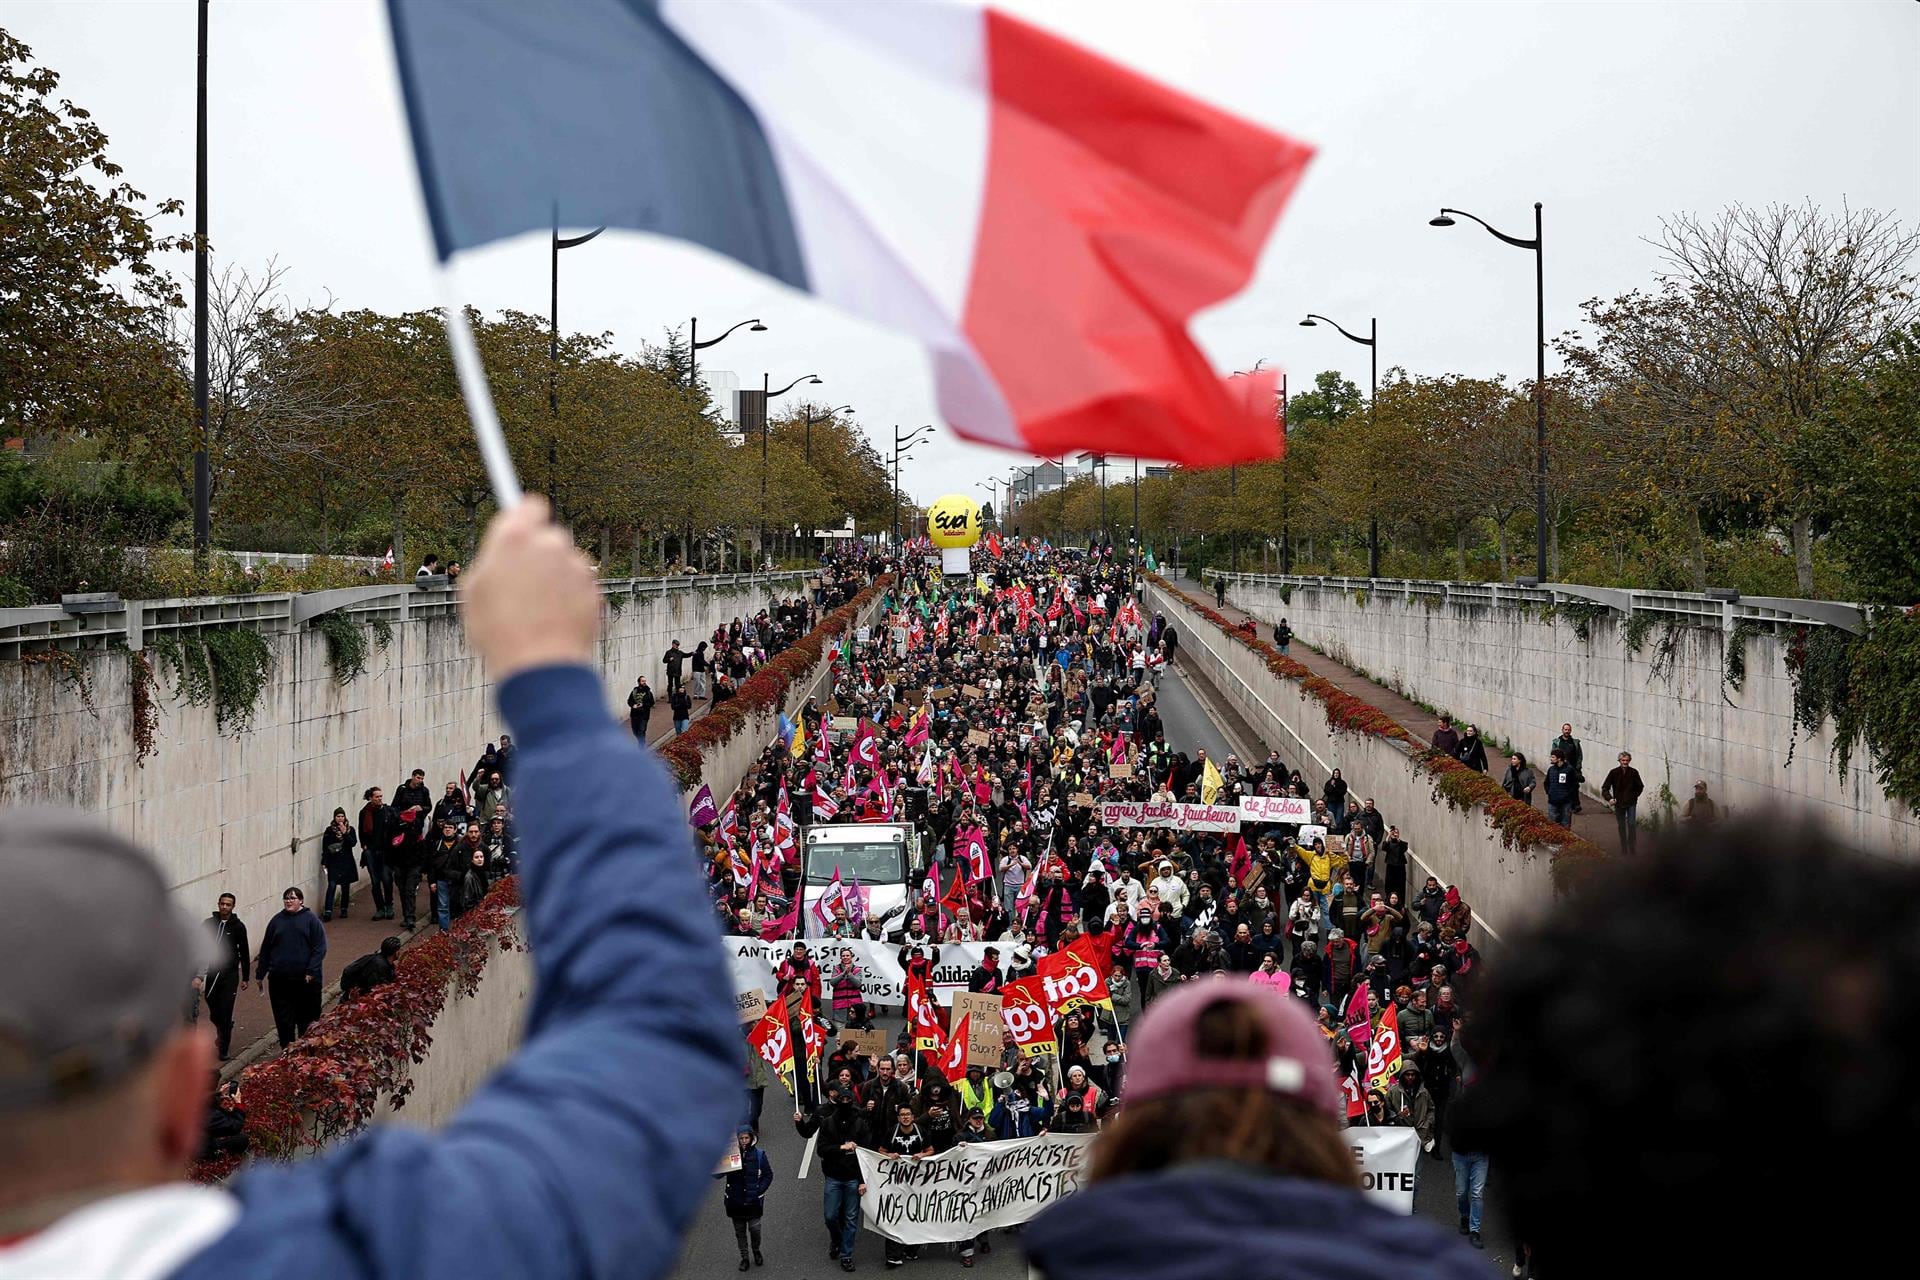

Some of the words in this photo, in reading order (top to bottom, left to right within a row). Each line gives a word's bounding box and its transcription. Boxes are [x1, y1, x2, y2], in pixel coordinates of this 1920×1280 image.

[1104, 806, 1138, 825] agris
[1178, 804, 1236, 827] faucheurs
[1244, 797, 1259, 812] de
[1259, 798, 1303, 817] fachos
[962, 999, 973, 1009] SI
[980, 1001, 998, 1012] T'ES
[973, 1011, 986, 1020] PAS
[877, 1159, 978, 1188] SAINT-DENIS
[981, 1144, 1085, 1180] ANTIFASCISTE
[1360, 1171, 1414, 1191] OITE
[876, 1193, 904, 1225] NOS
[906, 1189, 978, 1224] QUARTIERS
[981, 1170, 1078, 1215] ANTIRACISTES
